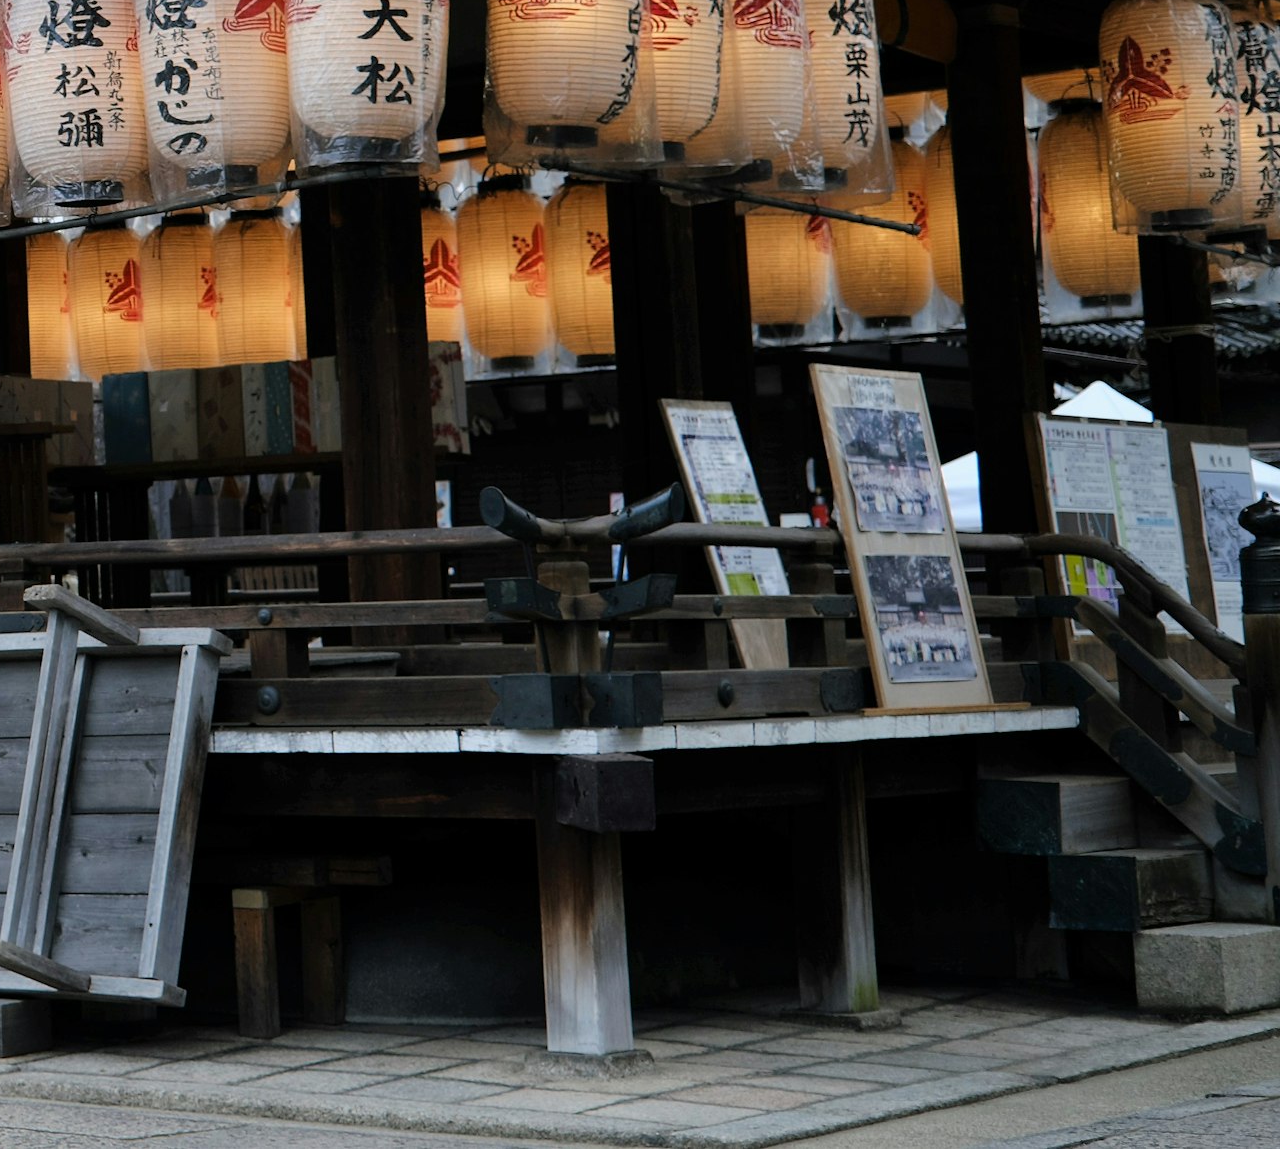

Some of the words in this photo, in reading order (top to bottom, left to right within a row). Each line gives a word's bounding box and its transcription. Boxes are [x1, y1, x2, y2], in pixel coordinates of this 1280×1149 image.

[351, 0, 417, 106] 大松
[843, 43, 870, 147] 栗山茂
[154, 58, 215, 156] かじの
[1199, 124, 1215, 180] 竹寺西
